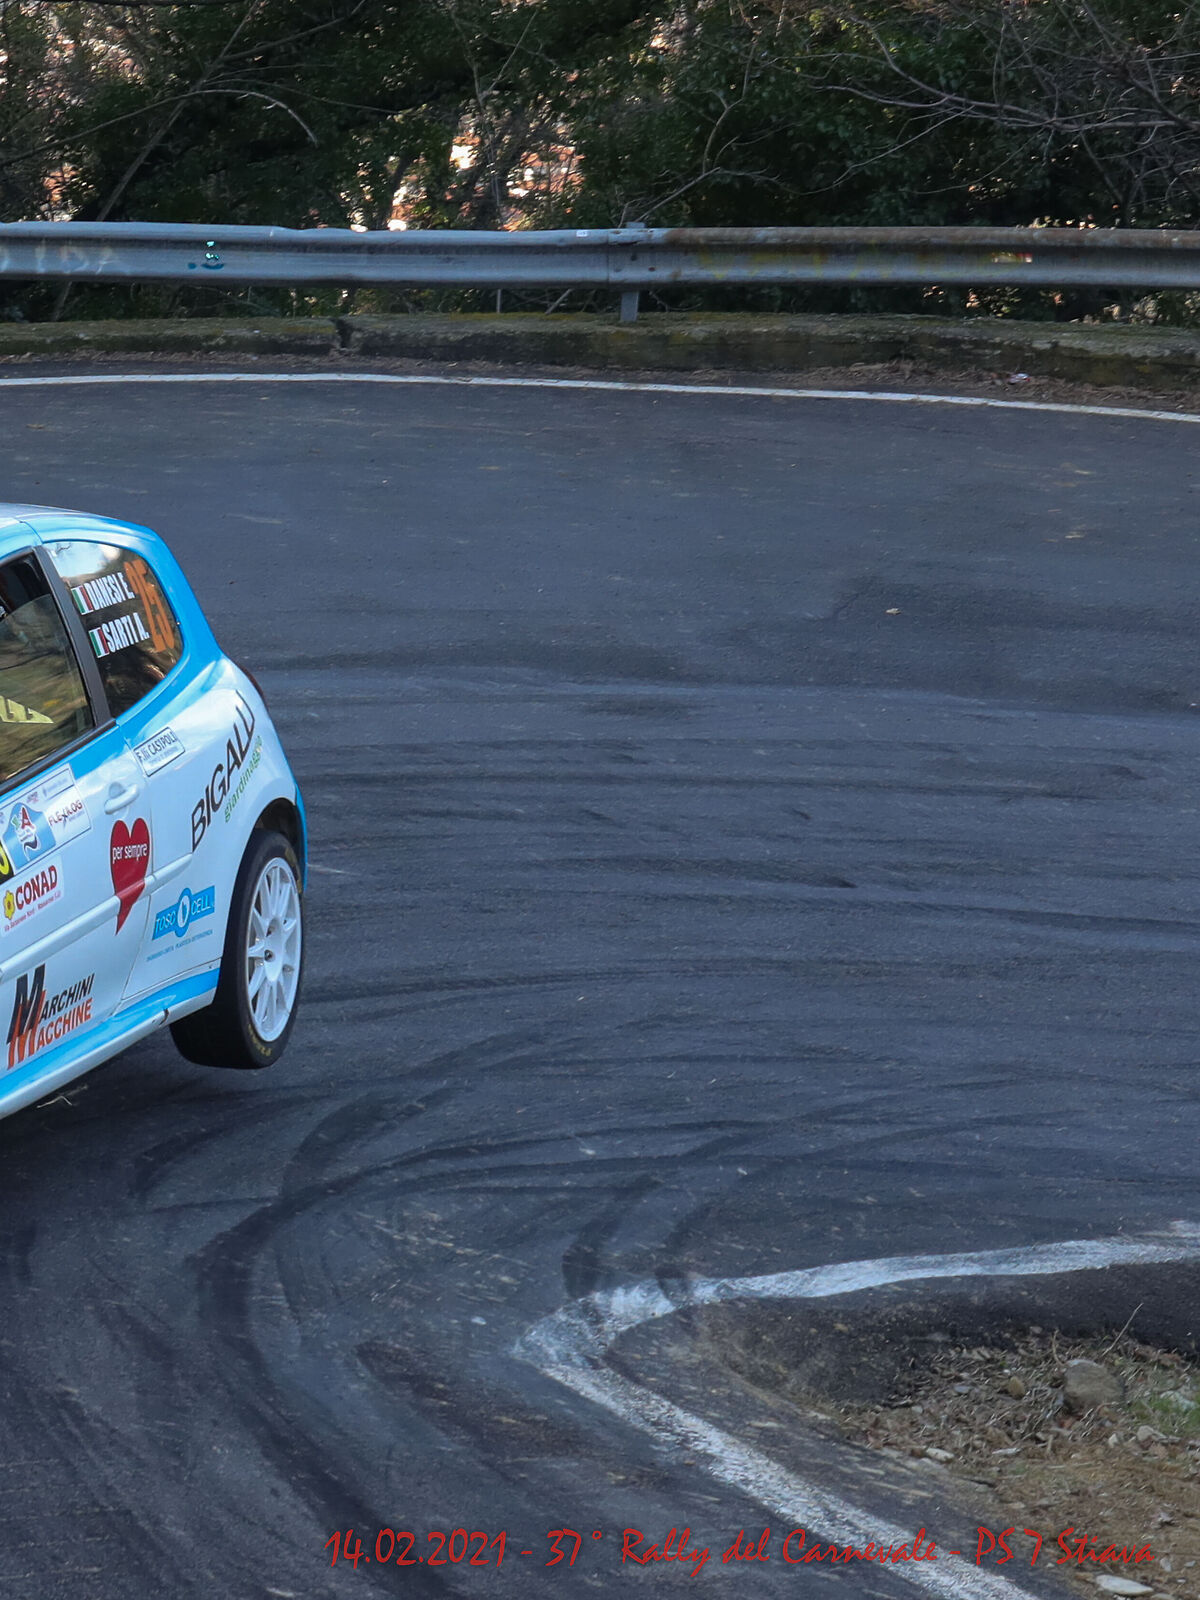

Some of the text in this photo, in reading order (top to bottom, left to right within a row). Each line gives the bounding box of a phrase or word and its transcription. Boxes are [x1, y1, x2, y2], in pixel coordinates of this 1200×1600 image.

[101, 615, 140, 653] SARTI
[112, 842, 148, 864] per sempre
[15, 865, 58, 910] CONAD
